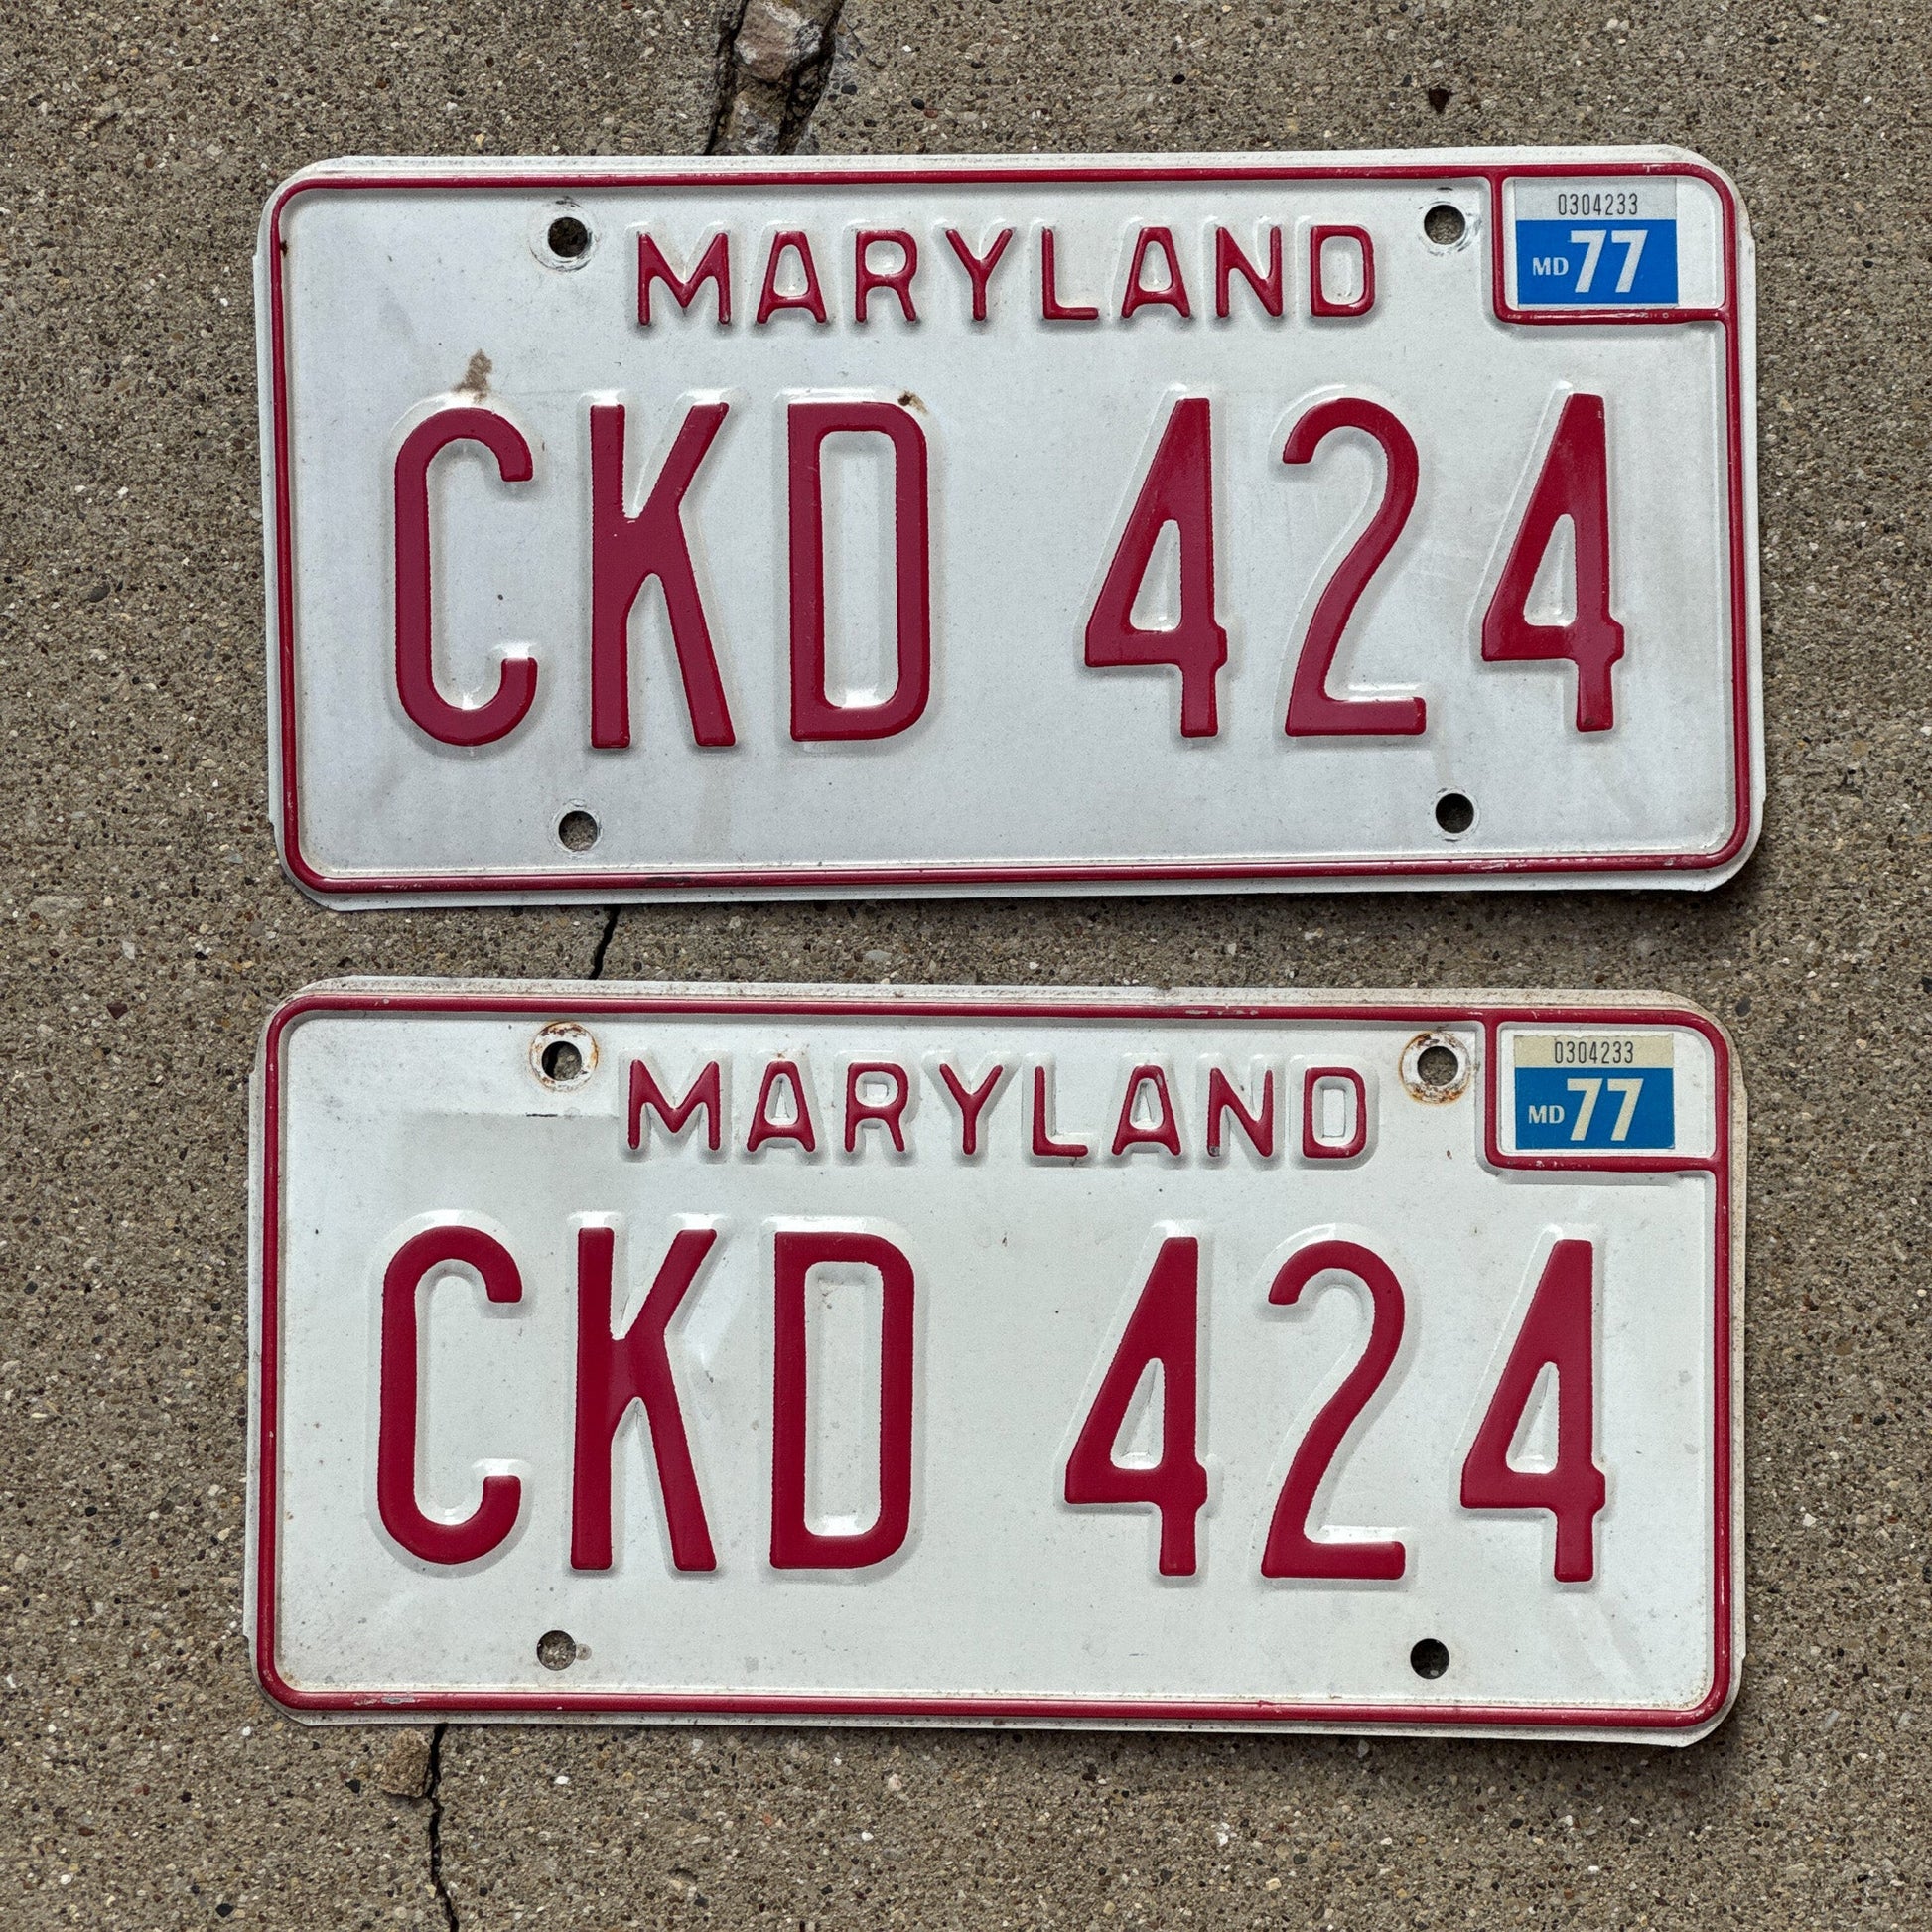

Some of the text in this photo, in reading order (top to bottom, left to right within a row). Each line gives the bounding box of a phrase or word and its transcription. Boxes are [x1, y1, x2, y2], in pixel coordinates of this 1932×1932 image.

[1558, 192, 1638, 216] 0304233
[637, 225, 1375, 327] MARYLAND
[1532, 229, 1649, 293] MD 77
[394, 393, 1625, 752] CKD 424
[1554, 1040, 1634, 1064] 0304233
[627, 1060, 1367, 1159] MARYLAND
[1528, 1077, 1644, 1142] MD 77
[376, 1226, 1606, 1583] CKD 424
